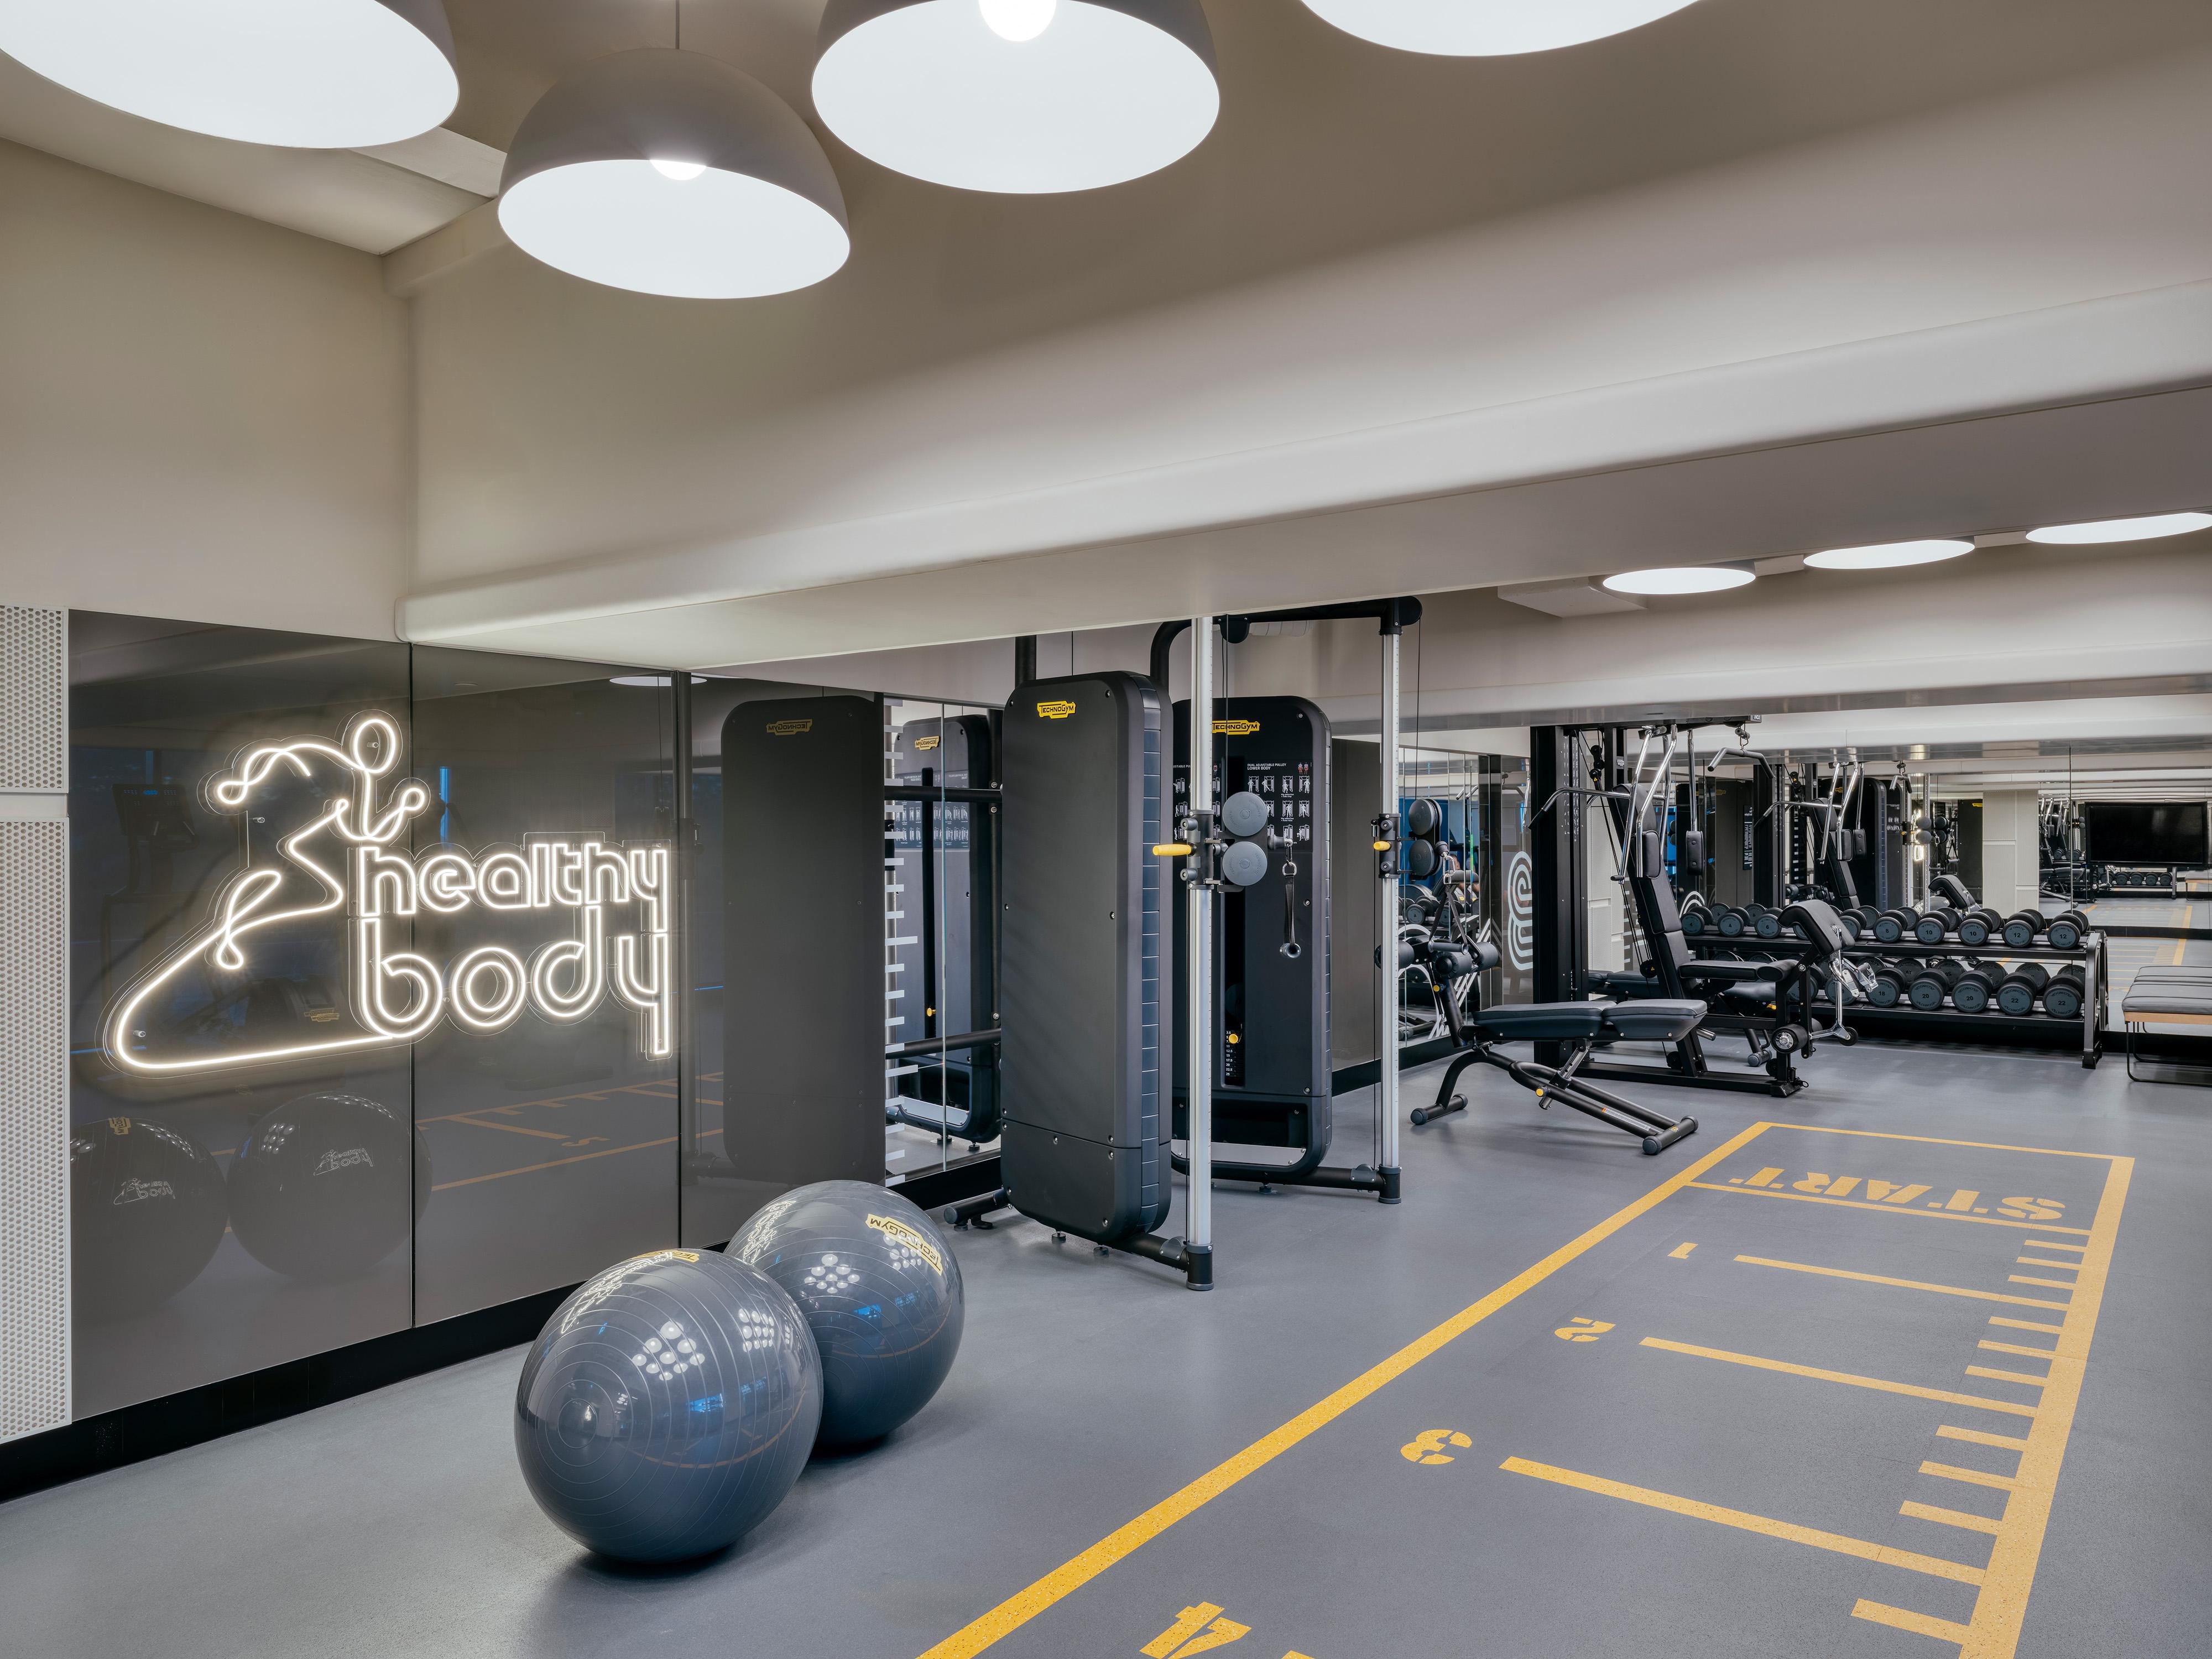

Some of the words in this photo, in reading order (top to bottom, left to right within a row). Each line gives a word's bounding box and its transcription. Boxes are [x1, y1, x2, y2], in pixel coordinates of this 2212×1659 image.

[357, 842, 670, 934] healthy
[357, 917, 671, 1055] body
[1728, 1167, 2066, 1220] START
[1667, 1242, 1699, 1259] 1
[1554, 1317, 1616, 1342] 2
[1400, 1429, 1472, 1465] 3
[1139, 1601, 1252, 1659] 4
